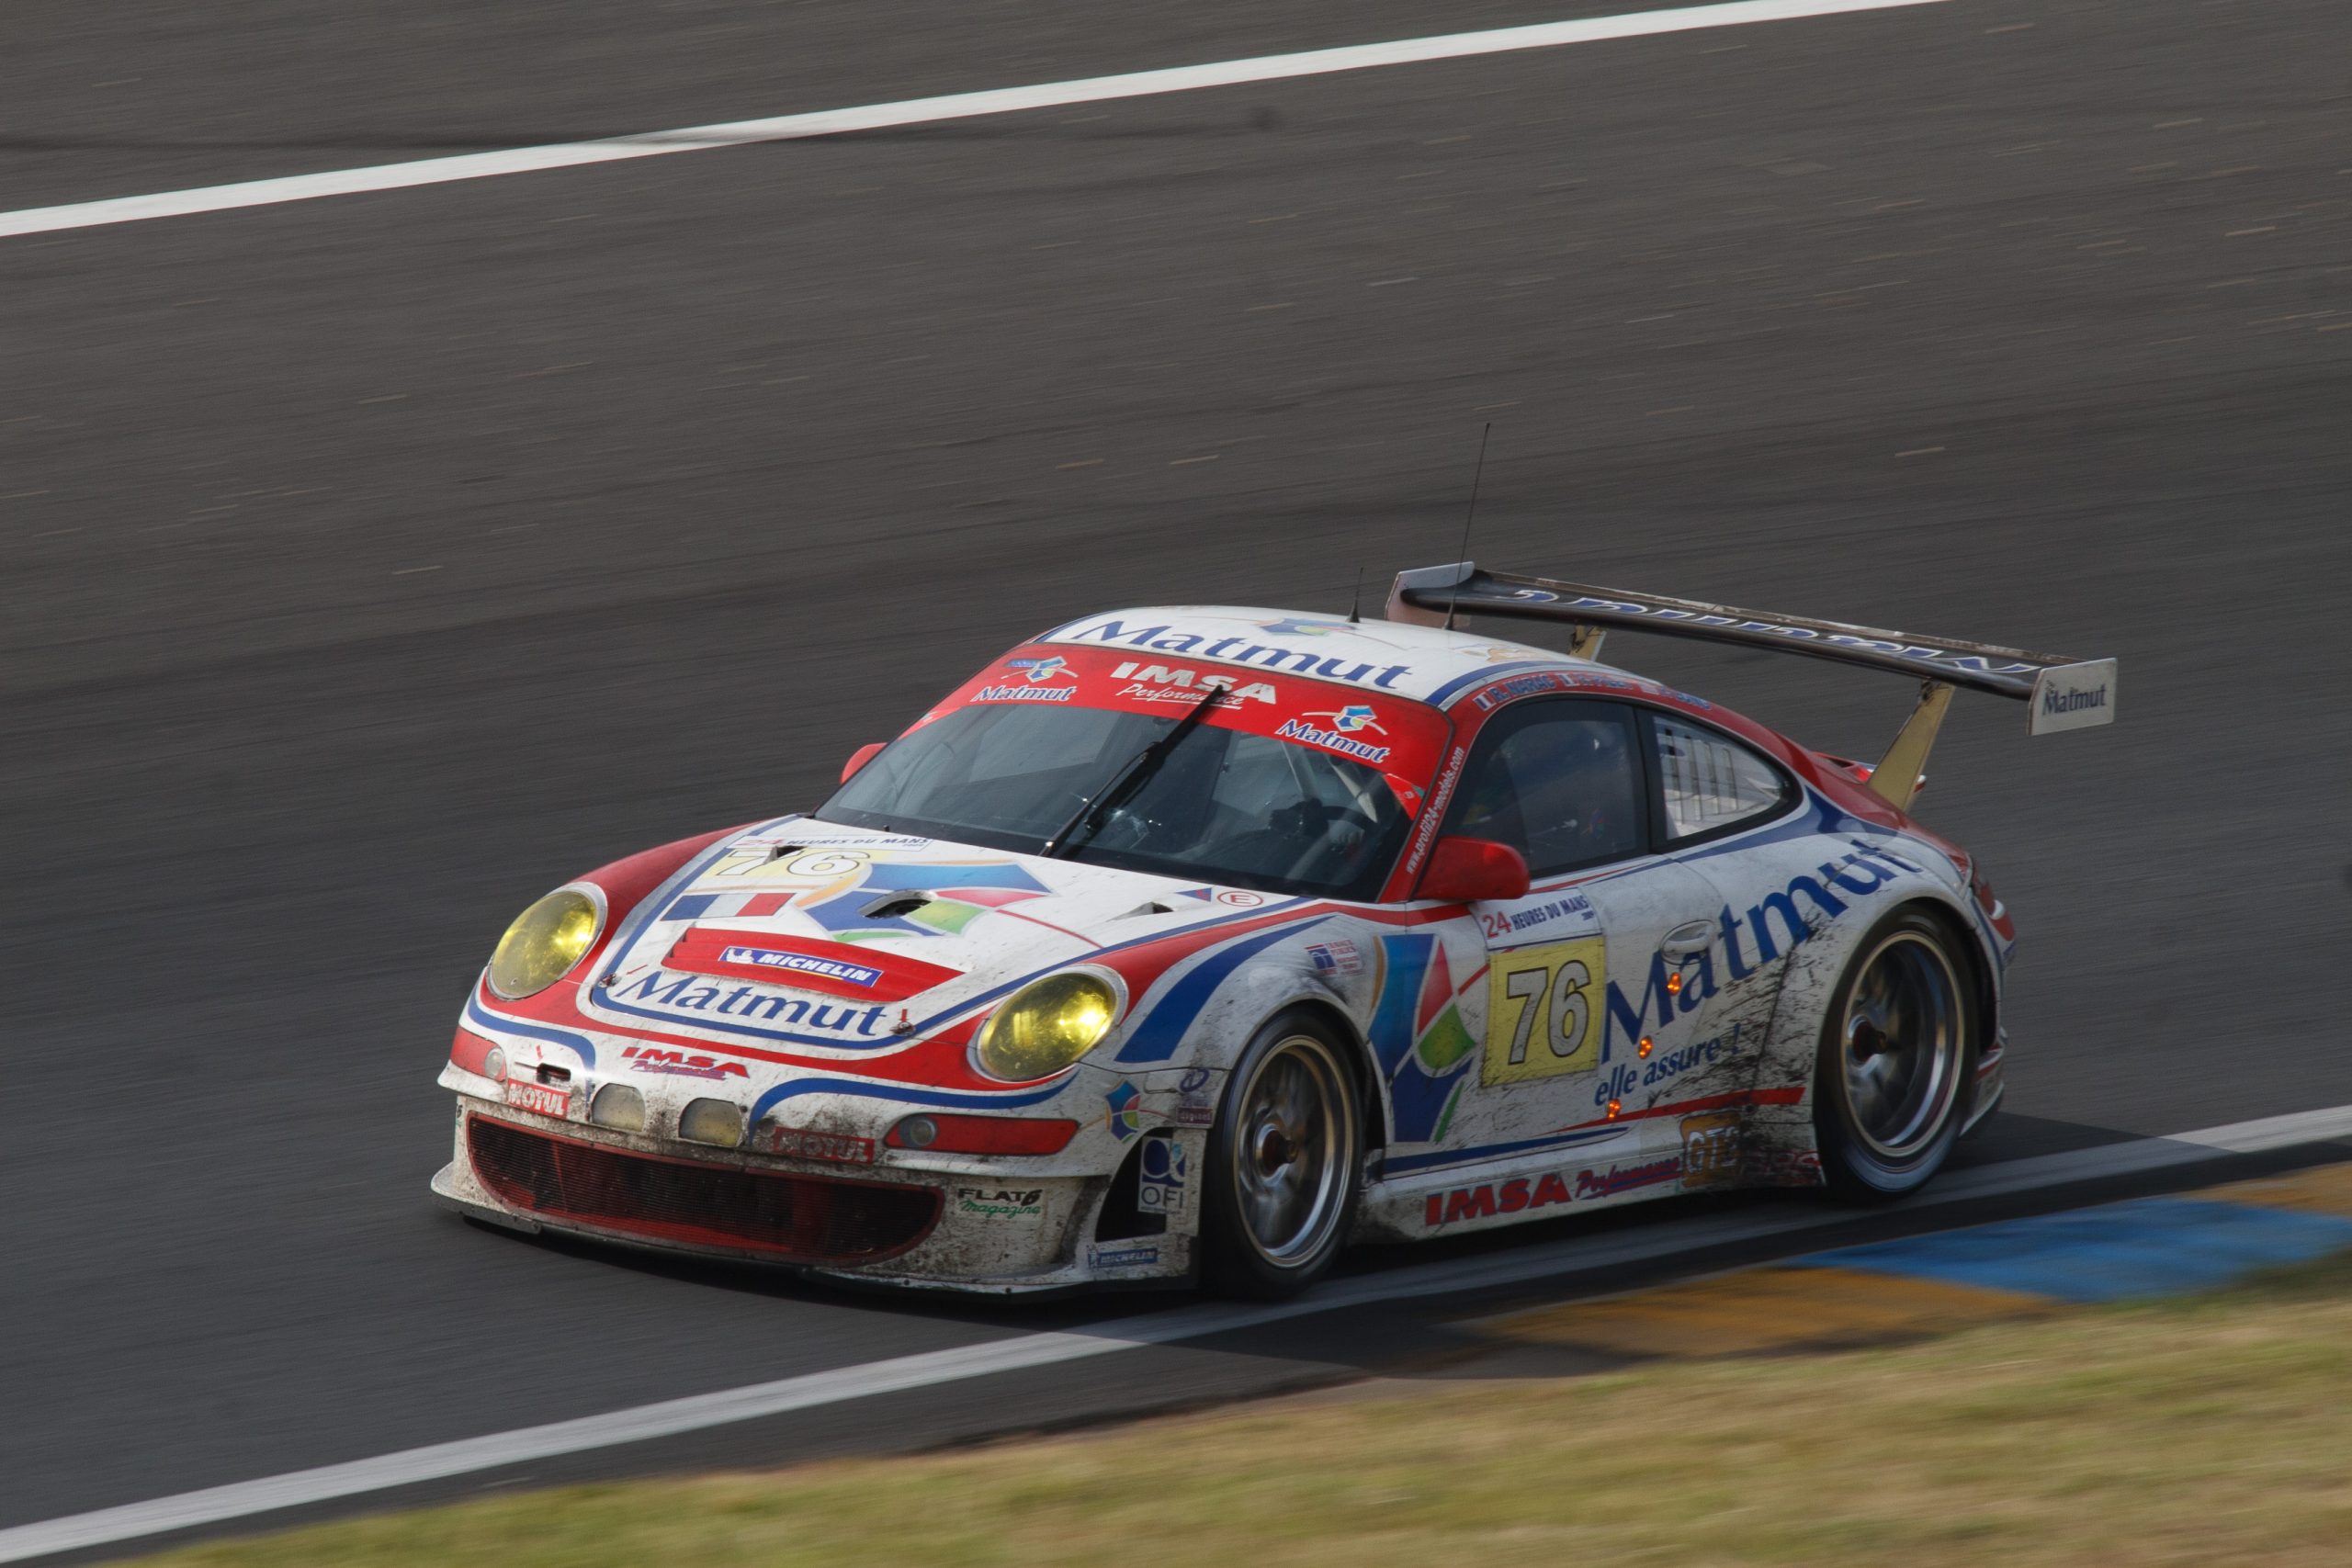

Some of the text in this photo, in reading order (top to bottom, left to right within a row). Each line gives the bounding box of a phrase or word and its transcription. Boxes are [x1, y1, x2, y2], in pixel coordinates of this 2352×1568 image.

[1071, 620, 1413, 689] Matmut
[971, 684, 1077, 704] Matmut
[1110, 661, 1277, 705] IMSA
[2042, 683, 2106, 716] Matmut
[1274, 717, 1390, 764] Matmut
[716, 850, 871, 877] 76
[1482, 910, 1512, 939] 24
[1510, 907, 1547, 931] HEURES
[1544, 903, 1561, 919] DU
[1559, 895, 1589, 916] MANS
[758, 953, 873, 981] MICHELIN
[1600, 840, 1924, 1065] Matmut
[615, 971, 888, 1037] Matmut
[1506, 959, 1592, 1066] 76
[621, 1046, 751, 1079] IMSA
[1595, 1063, 1637, 1106] elle
[1643, 1037, 1721, 1087] assure
[508, 1083, 565, 1115] MOTUL
[779, 1131, 868, 1162] MOTUL
[1425, 1171, 1573, 1226] IMSA
